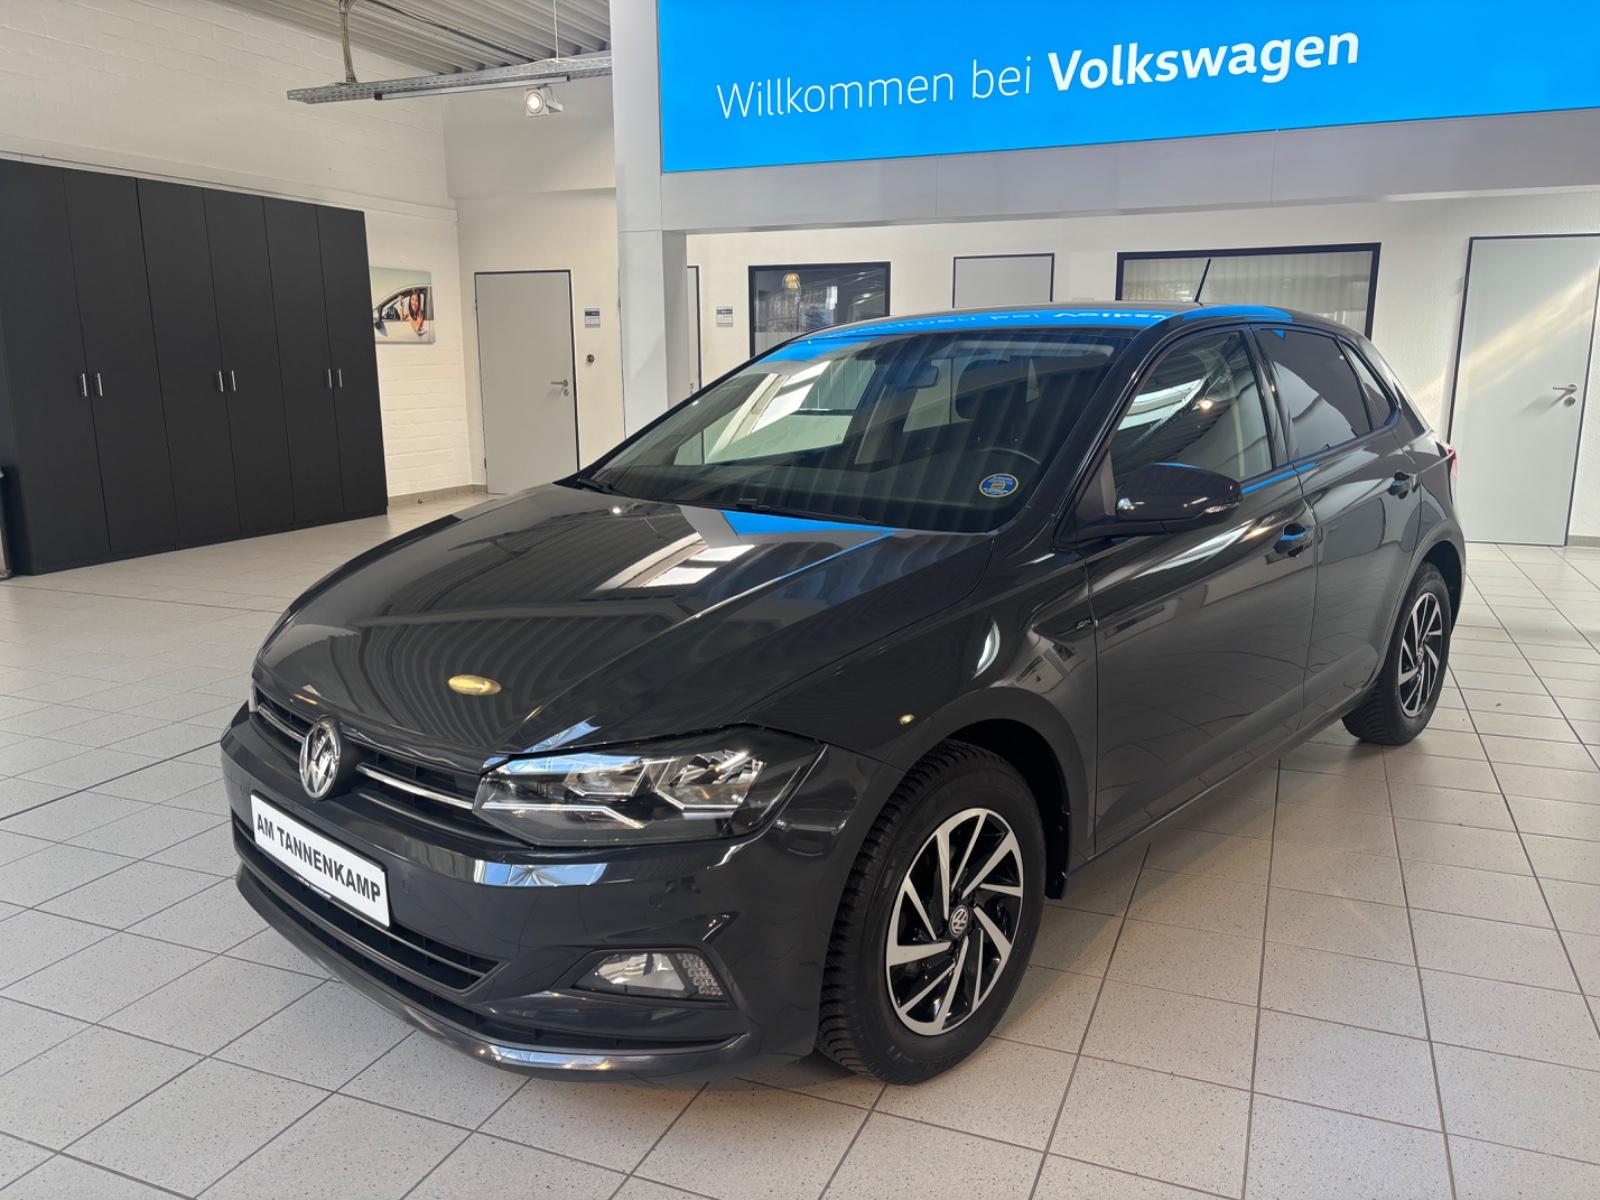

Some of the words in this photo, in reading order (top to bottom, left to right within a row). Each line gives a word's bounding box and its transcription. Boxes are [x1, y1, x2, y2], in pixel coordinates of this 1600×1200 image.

[716, 70, 955, 119] Willkommen
[970, 55, 1033, 99] bei
[1047, 31, 1360, 92] Volkswagen
[257, 813, 275, 841] AM
[276, 826, 381, 903] TANNENKAMP
